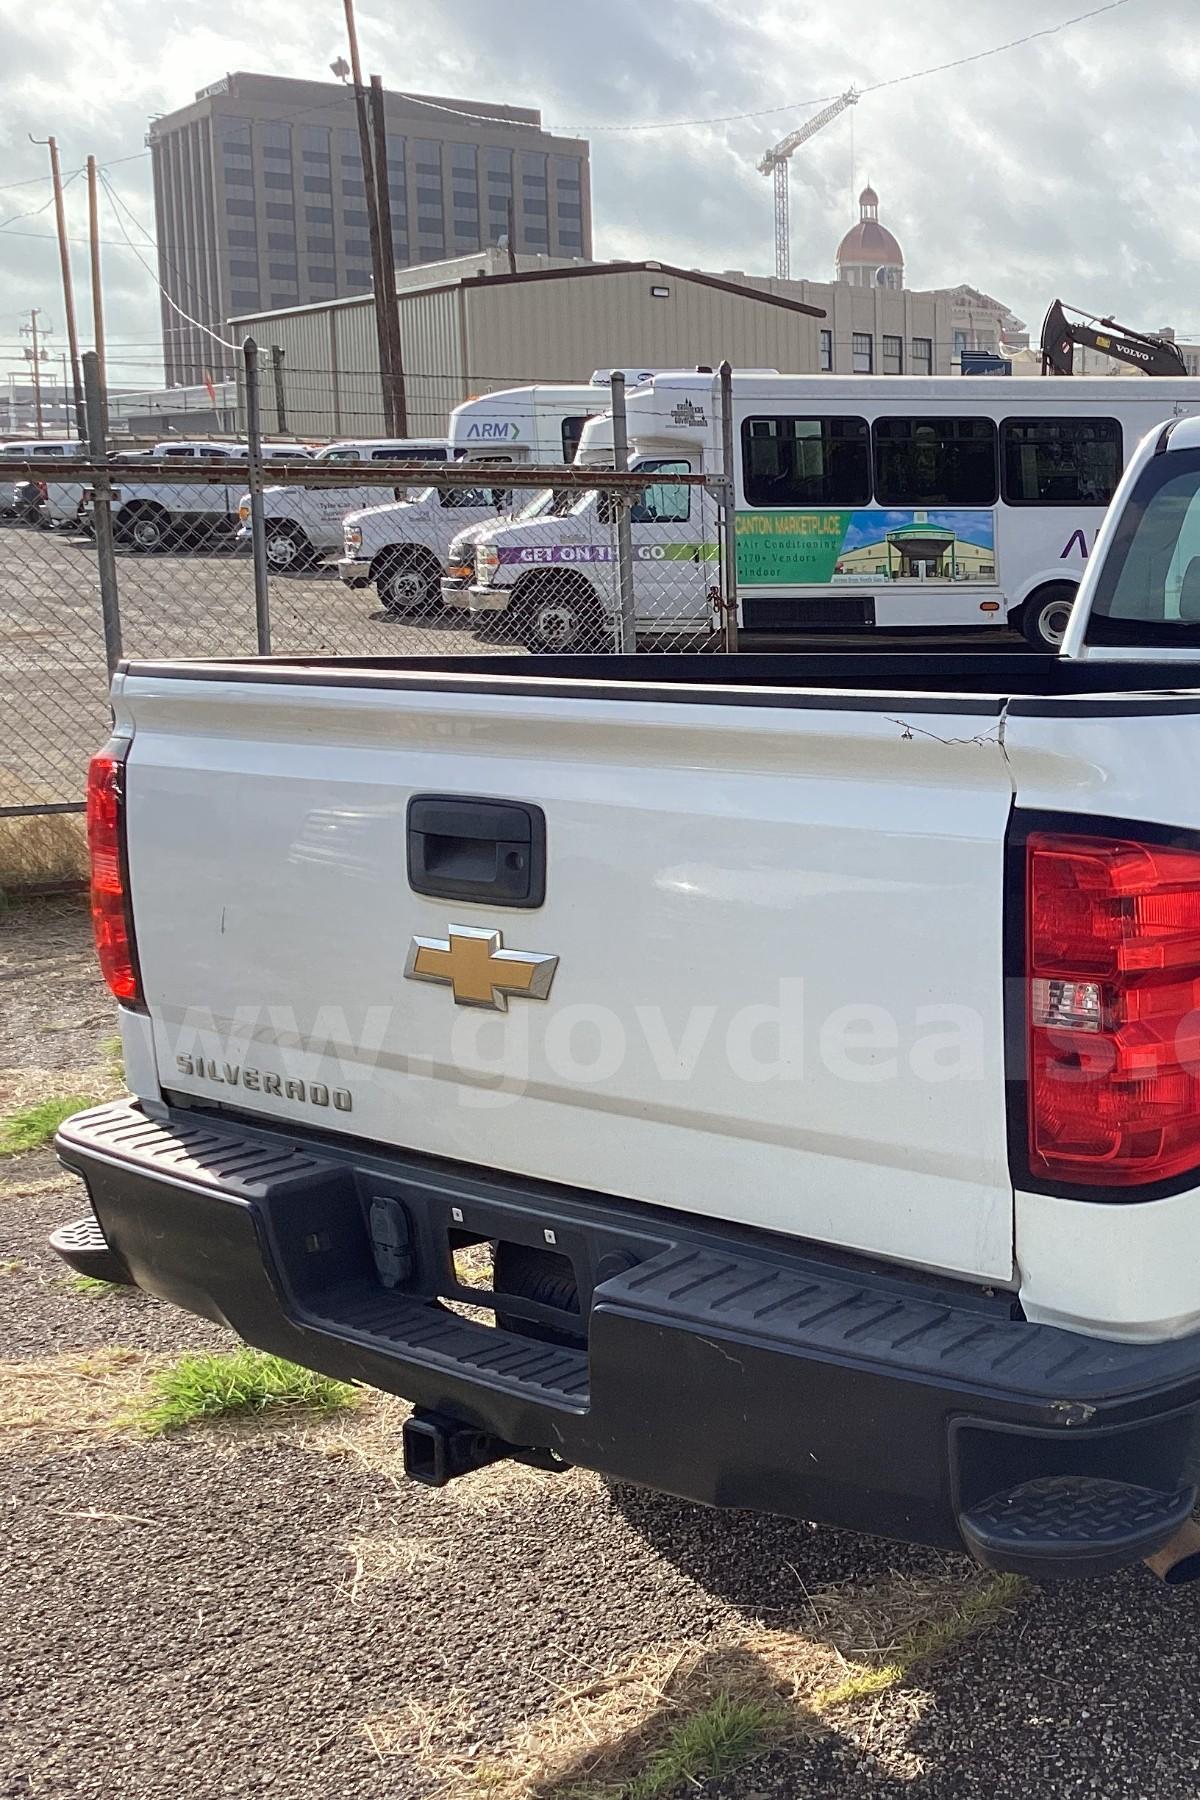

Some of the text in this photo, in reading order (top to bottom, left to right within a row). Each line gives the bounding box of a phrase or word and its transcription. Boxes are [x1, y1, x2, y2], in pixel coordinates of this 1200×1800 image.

[1115, 343, 1149, 361] VOLVO
[466, 423, 508, 437] ARM
[735, 515, 841, 534] CANTON MARKETPLACE
[764, 540, 837, 550] Conditioning
[520, 548, 552, 562] GET
[560, 547, 591, 562] ON
[638, 546, 666, 560] GO
[772, 553, 817, 563] Vendors
[745, 567, 781, 577] Indoor
[175, 1052, 353, 1113] SILVERADO
